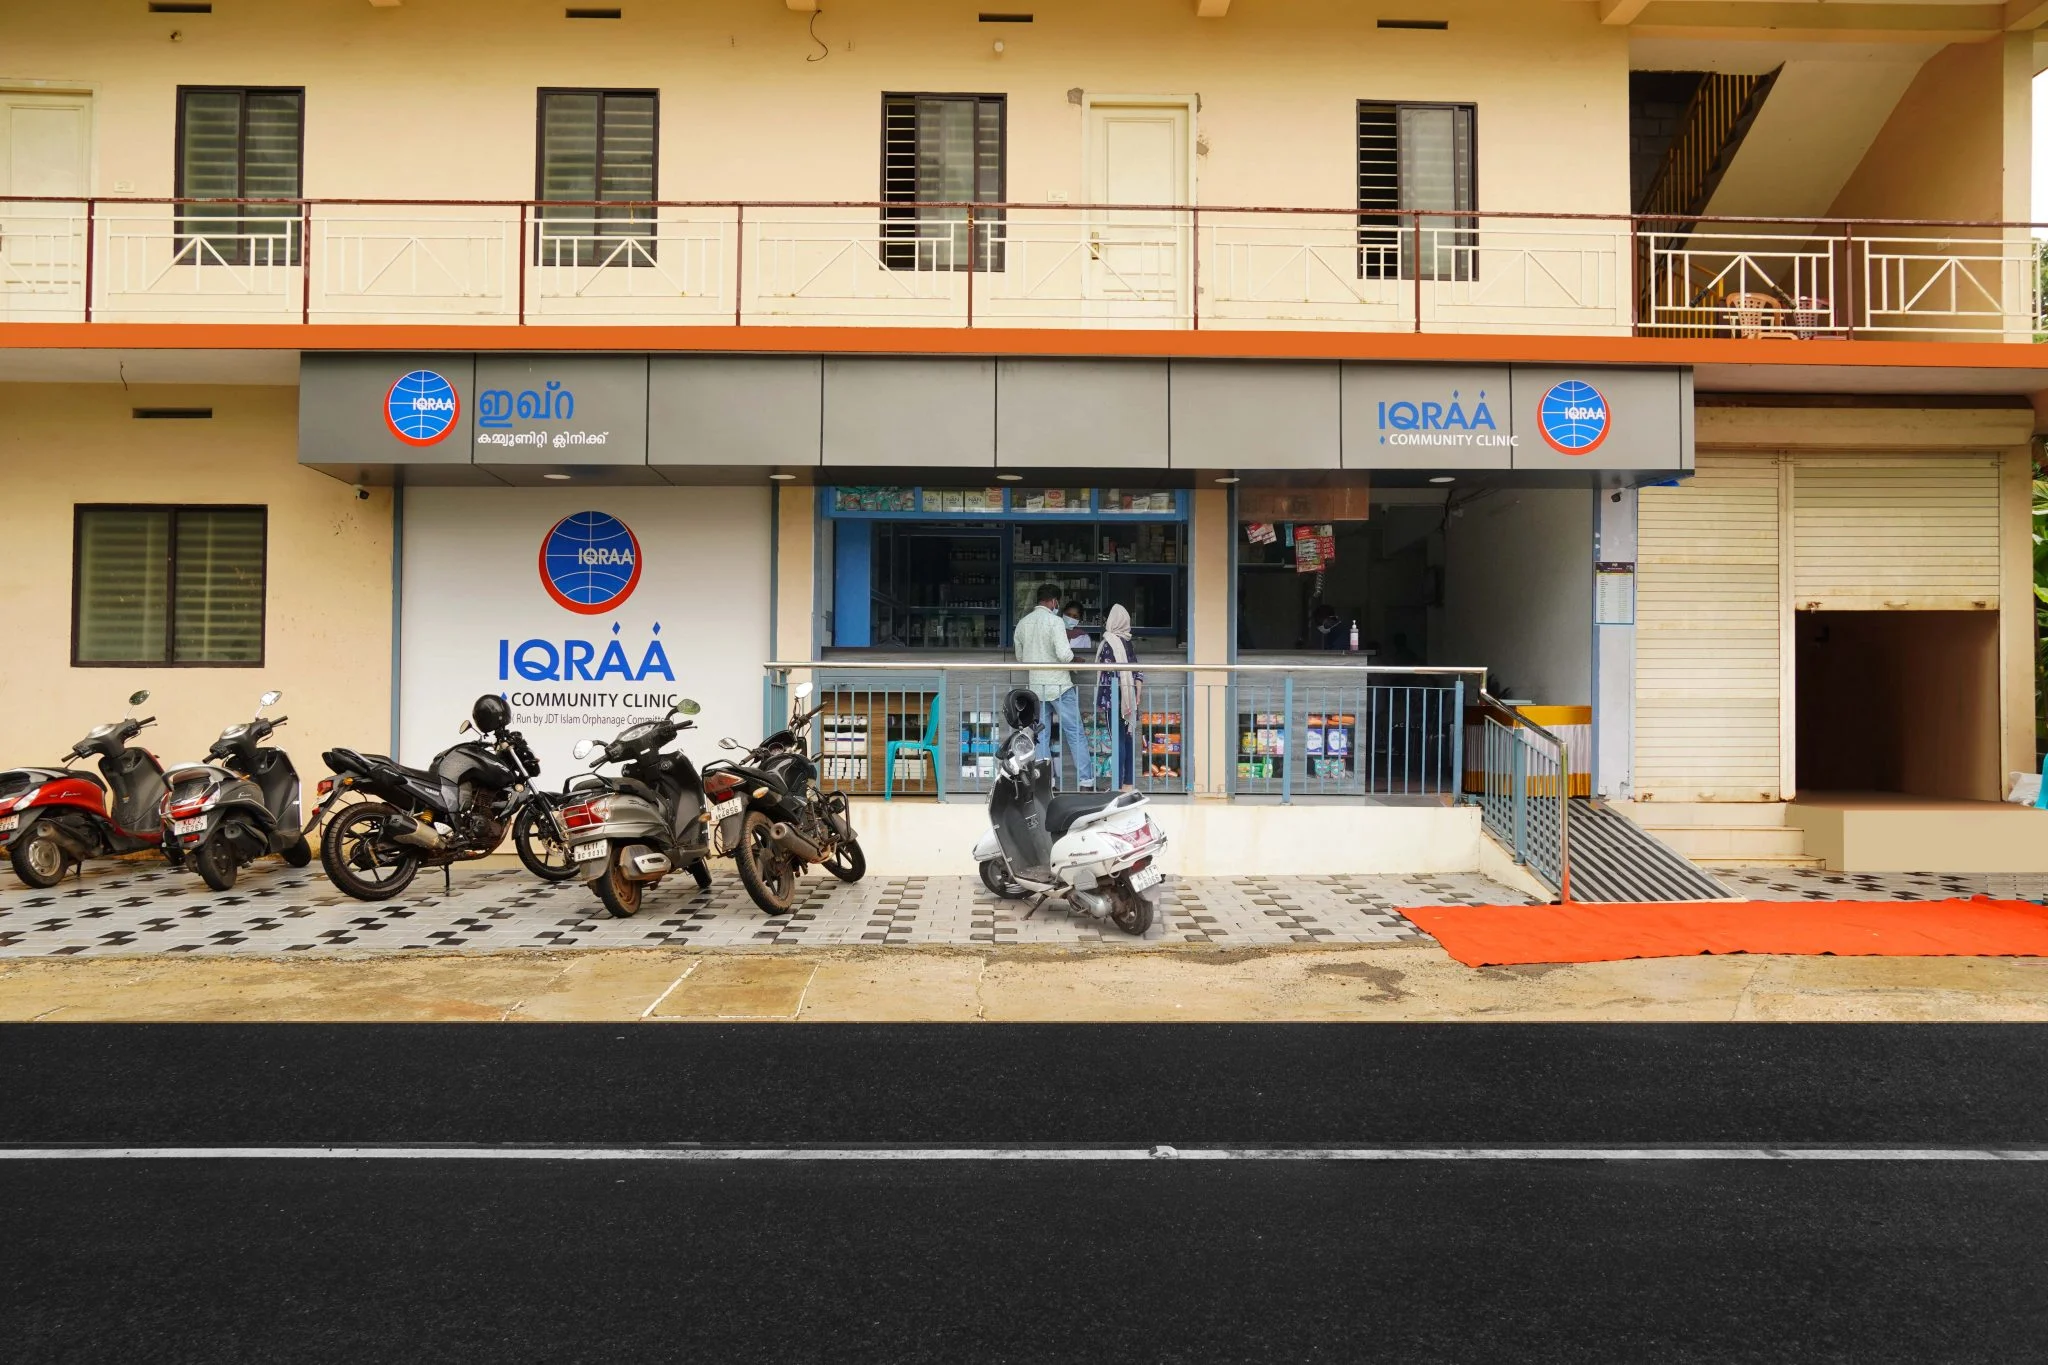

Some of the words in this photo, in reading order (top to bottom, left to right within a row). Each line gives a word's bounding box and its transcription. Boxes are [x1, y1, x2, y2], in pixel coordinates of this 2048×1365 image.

[412, 397, 454, 411] IQRAA
[1564, 406, 1605, 421] IQRAA
[1389, 433, 1473, 447] COMMUNITY
[1476, 434, 1519, 447] CLINIC
[578, 547, 633, 565] IQRAA
[511, 692, 618, 707] COMMUNITY
[622, 693, 678, 708] CLINIC
[533, 713, 544, 727] by
[544, 713, 559, 724] JDT
[560, 713, 581, 725] Islam
[582, 714, 626, 728] Orphanage
